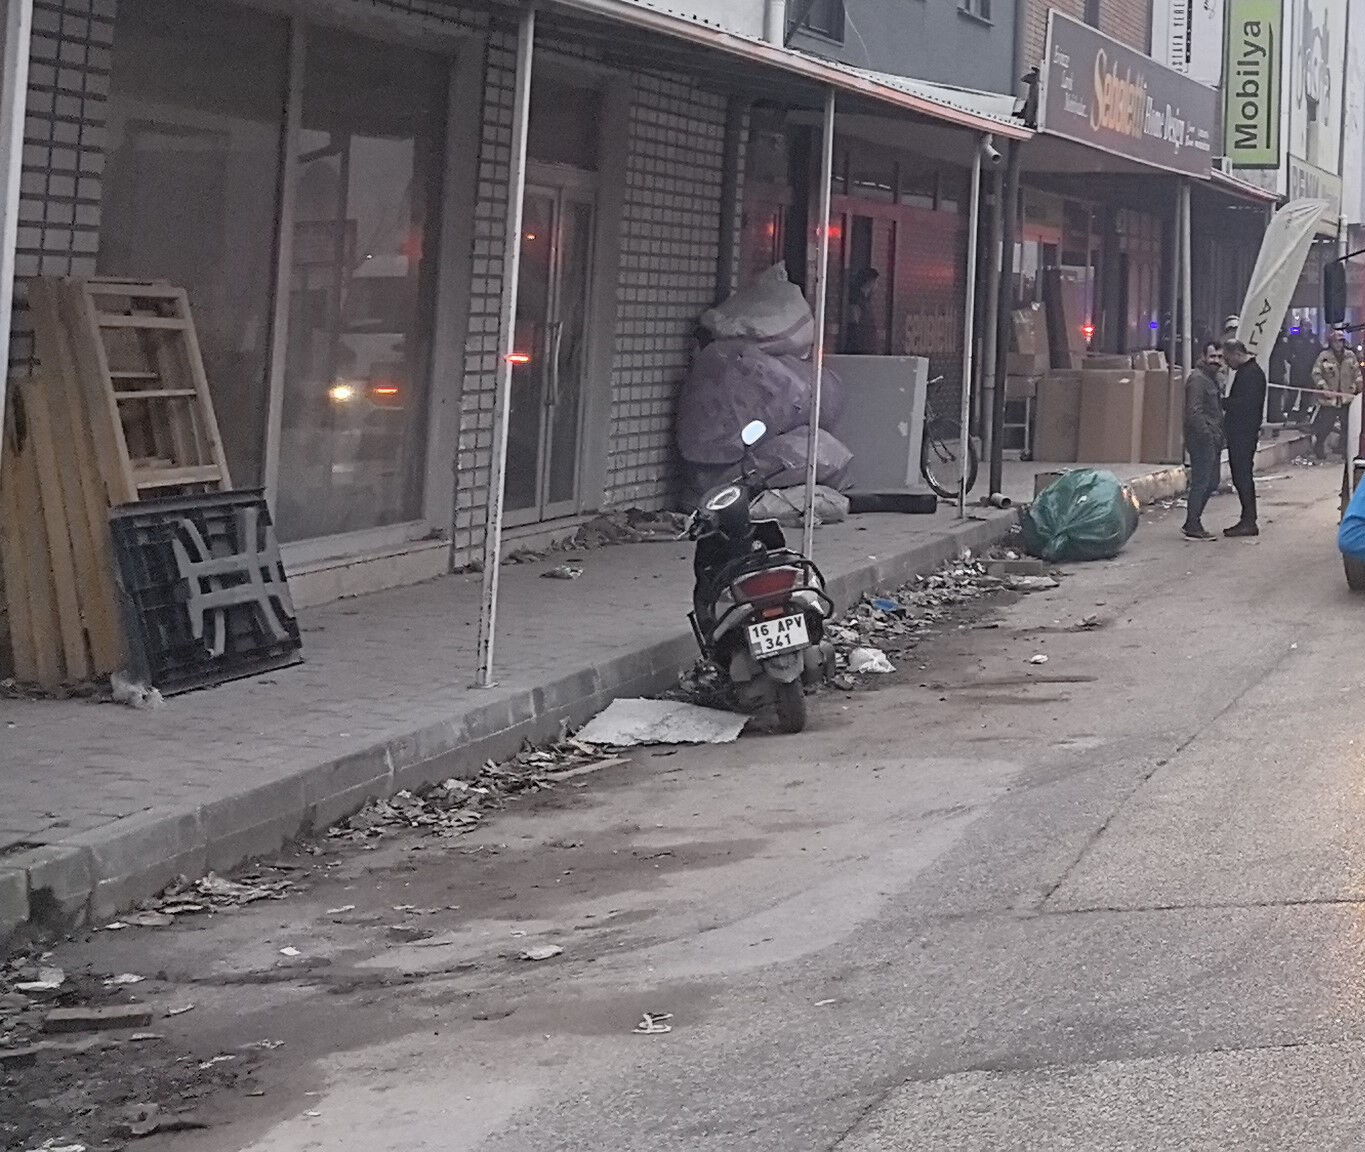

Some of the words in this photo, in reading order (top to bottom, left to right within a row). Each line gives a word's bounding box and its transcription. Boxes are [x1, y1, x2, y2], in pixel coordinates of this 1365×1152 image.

[1234, 20, 1267, 150] Mobilya
[753, 624, 769, 638] 16
[778, 615, 802, 633] APV
[765, 633, 792, 649] 341
